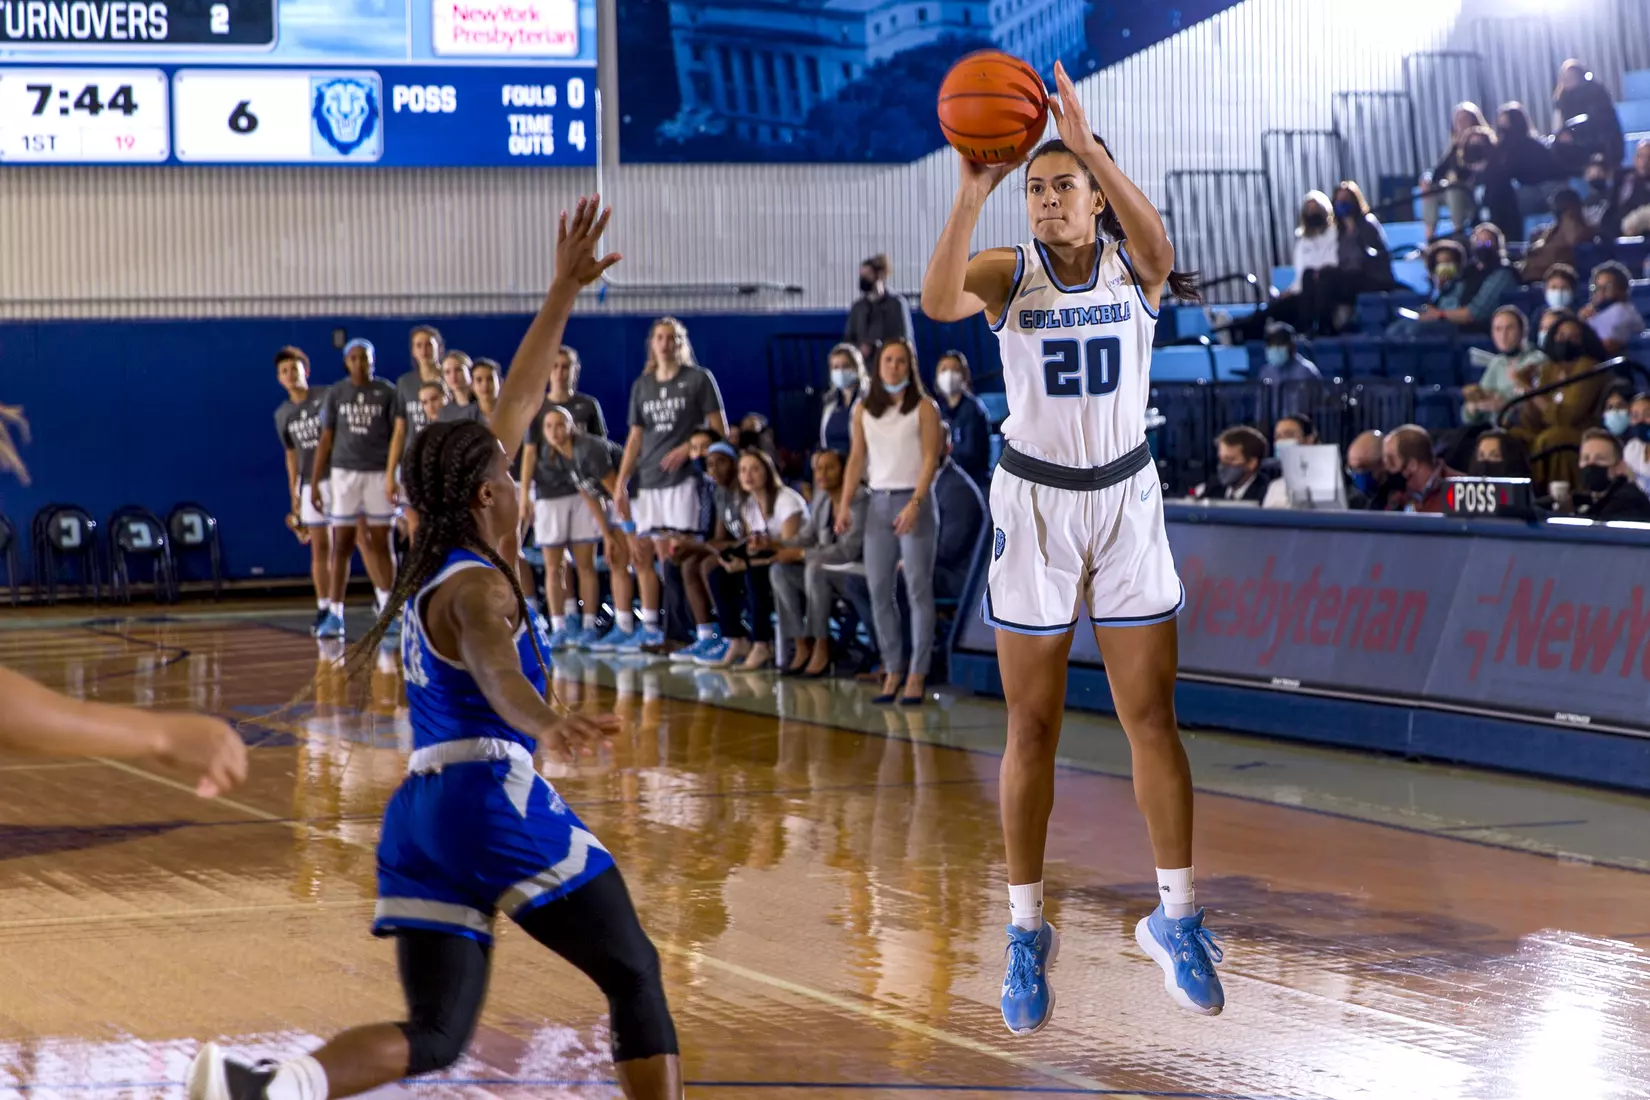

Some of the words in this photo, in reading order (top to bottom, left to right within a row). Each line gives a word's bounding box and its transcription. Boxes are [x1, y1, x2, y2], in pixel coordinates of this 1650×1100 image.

[0, 2, 168, 39] URNOVERS
[210, 4, 229, 34] 2
[453, 25, 574, 51] Presbyterian
[26, 84, 138, 116] 7:44
[392, 85, 457, 113] POSS
[502, 85, 557, 107] FOULS
[567, 77, 585, 109] 0
[228, 100, 258, 135] 6
[22, 134, 57, 151] 1ST
[115, 135, 135, 150] 19
[508, 114, 554, 134] TIME
[567, 120, 586, 151] 4
[508, 135, 555, 156] OUTS
[1019, 301, 1131, 329] COLUMBIA
[1040, 335, 1122, 397] 20
[1454, 483, 1497, 512] POSS
